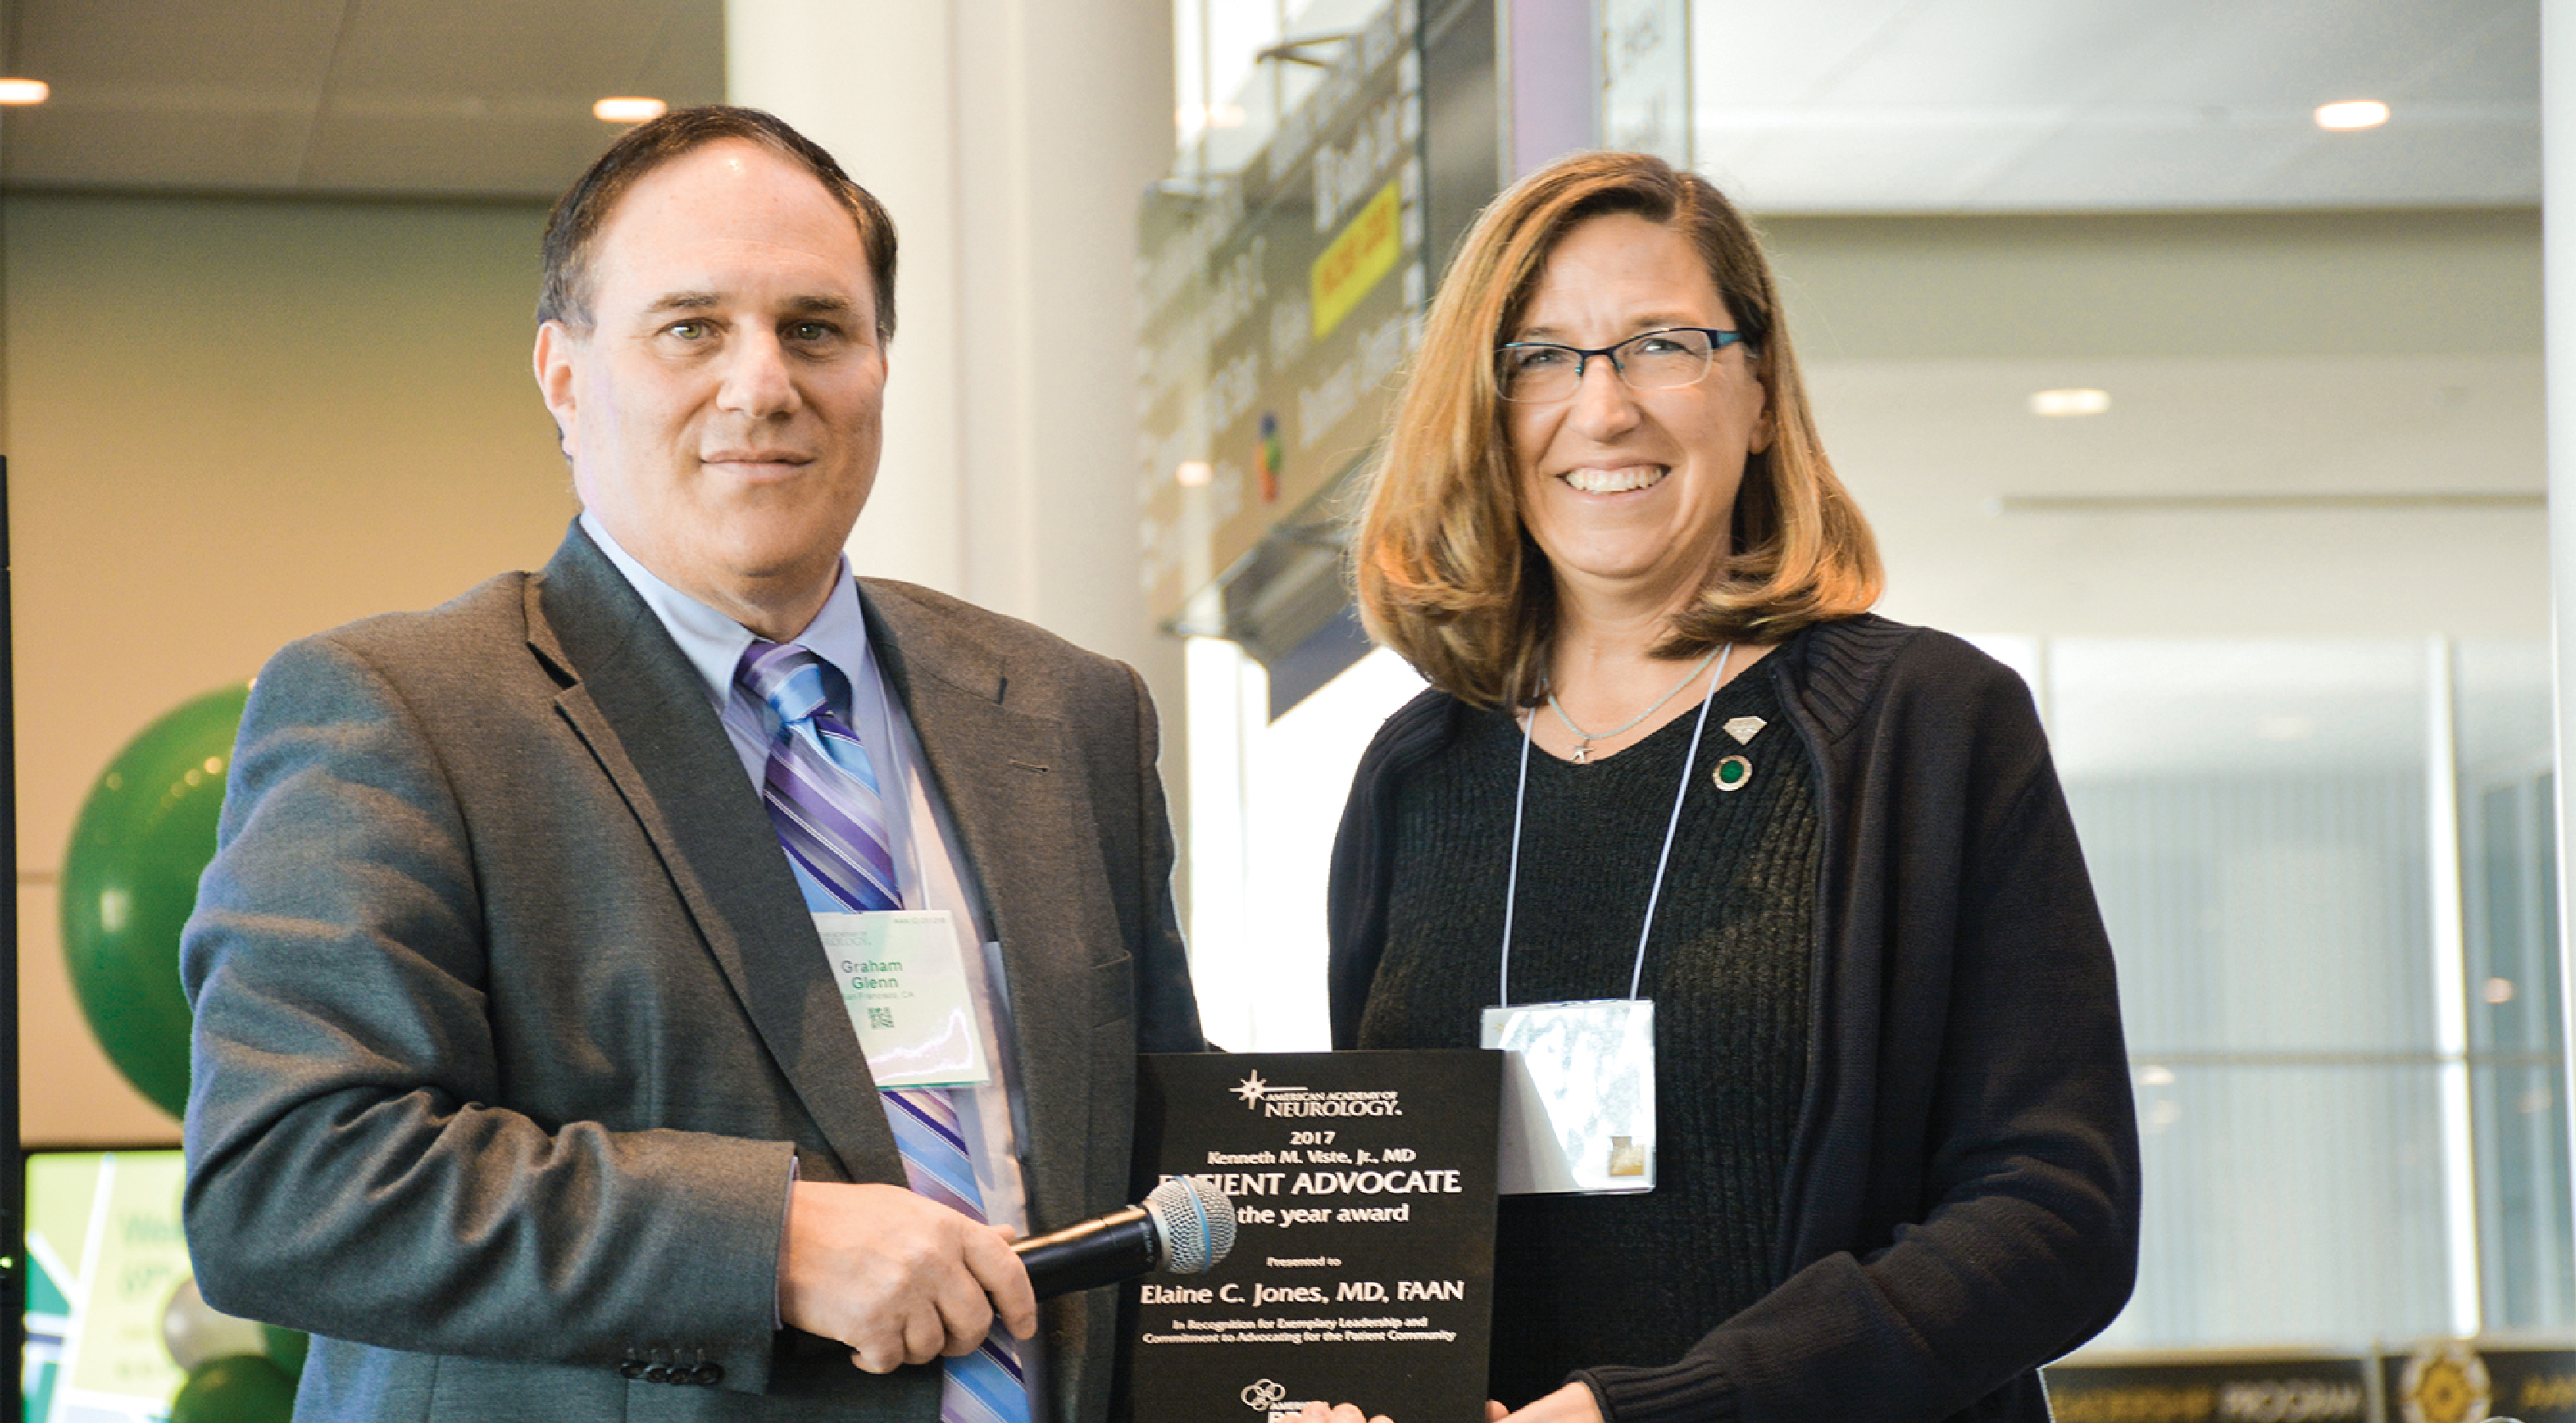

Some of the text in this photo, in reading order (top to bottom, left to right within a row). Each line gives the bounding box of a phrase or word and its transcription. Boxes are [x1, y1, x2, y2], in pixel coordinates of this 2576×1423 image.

[841, 960, 904, 974] Graham
[852, 977, 899, 990] Glenn
[1264, 1092, 1326, 1101] AMERICAN
[1327, 1091, 1381, 1101] ACADEMY
[1289, 1131, 1337, 1145] 2017
[1207, 1150, 1277, 1165] Kenneth
[1277, 1149, 1304, 1164] M.
[1306, 1149, 1353, 1165] Viste,
[1382, 1148, 1418, 1163] MD
[1290, 1169, 1463, 1195] ADVOCATE
[1237, 1202, 1411, 1228] the year award
[1265, 1255, 1343, 1268] Presented to
[1140, 1279, 1466, 1308] Elaine C. Jones, MD, FAAN
[1171, 1315, 1429, 1333] In Recognition for Exemplary Leadership and
[1141, 1328, 1458, 1345] Commitment to Advocating for the Patient Community
